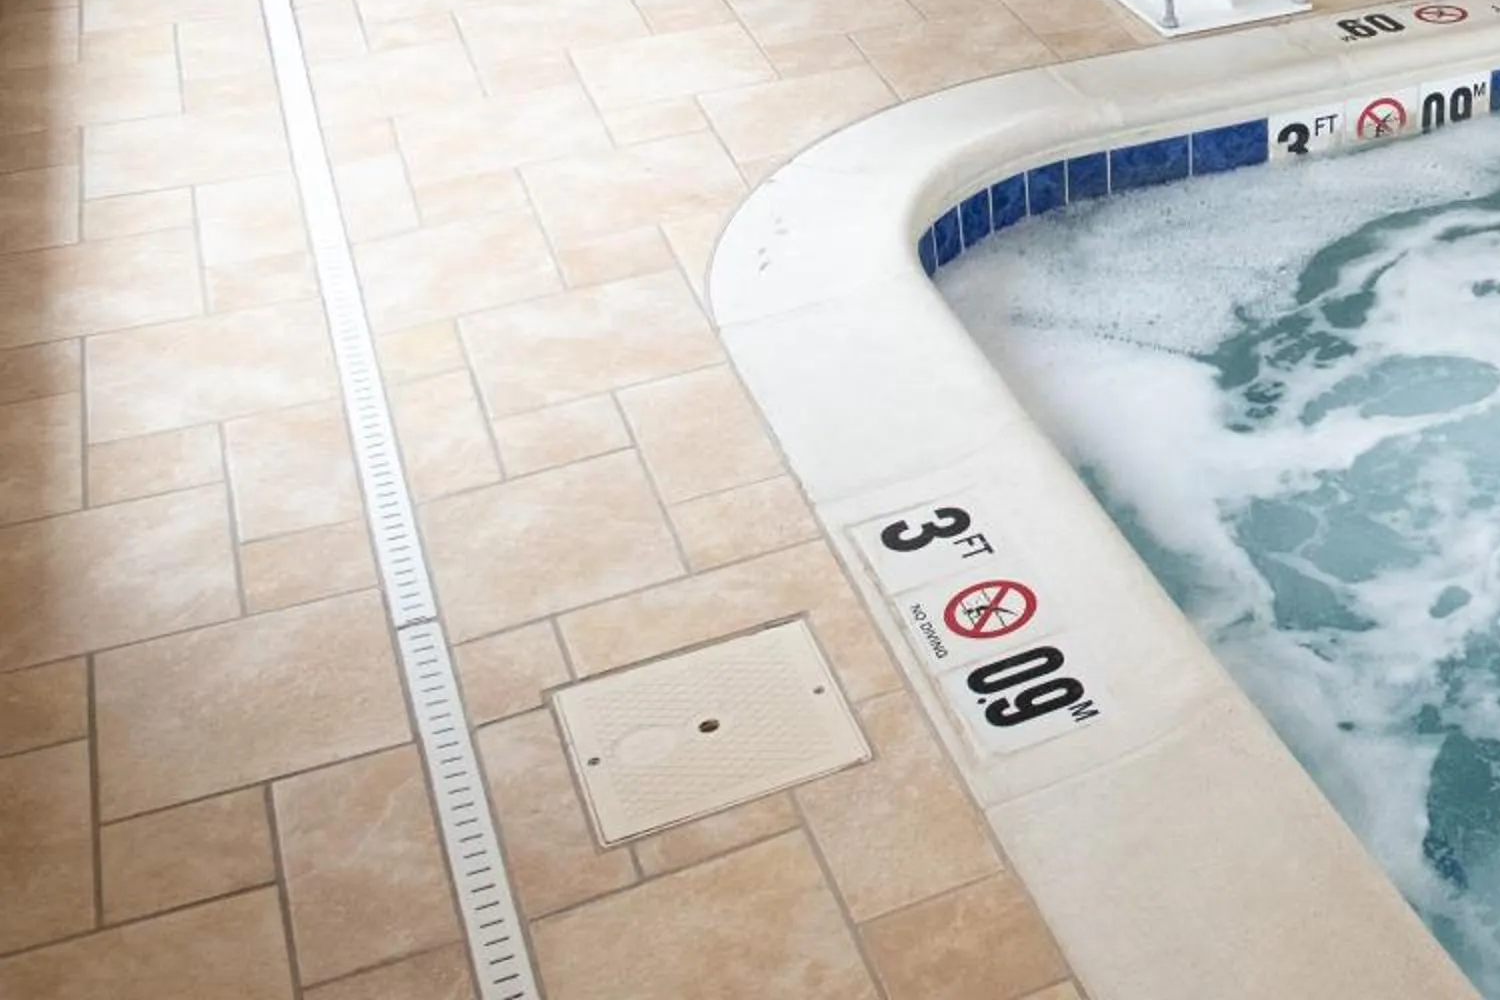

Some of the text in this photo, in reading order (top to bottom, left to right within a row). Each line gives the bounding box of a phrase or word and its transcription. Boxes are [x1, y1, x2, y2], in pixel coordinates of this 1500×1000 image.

[1315, 113, 1338, 136] FT
[881, 507, 995, 559] 3 FT
[910, 603, 949, 660] NO DIVING
[1068, 699, 1101, 723] M
